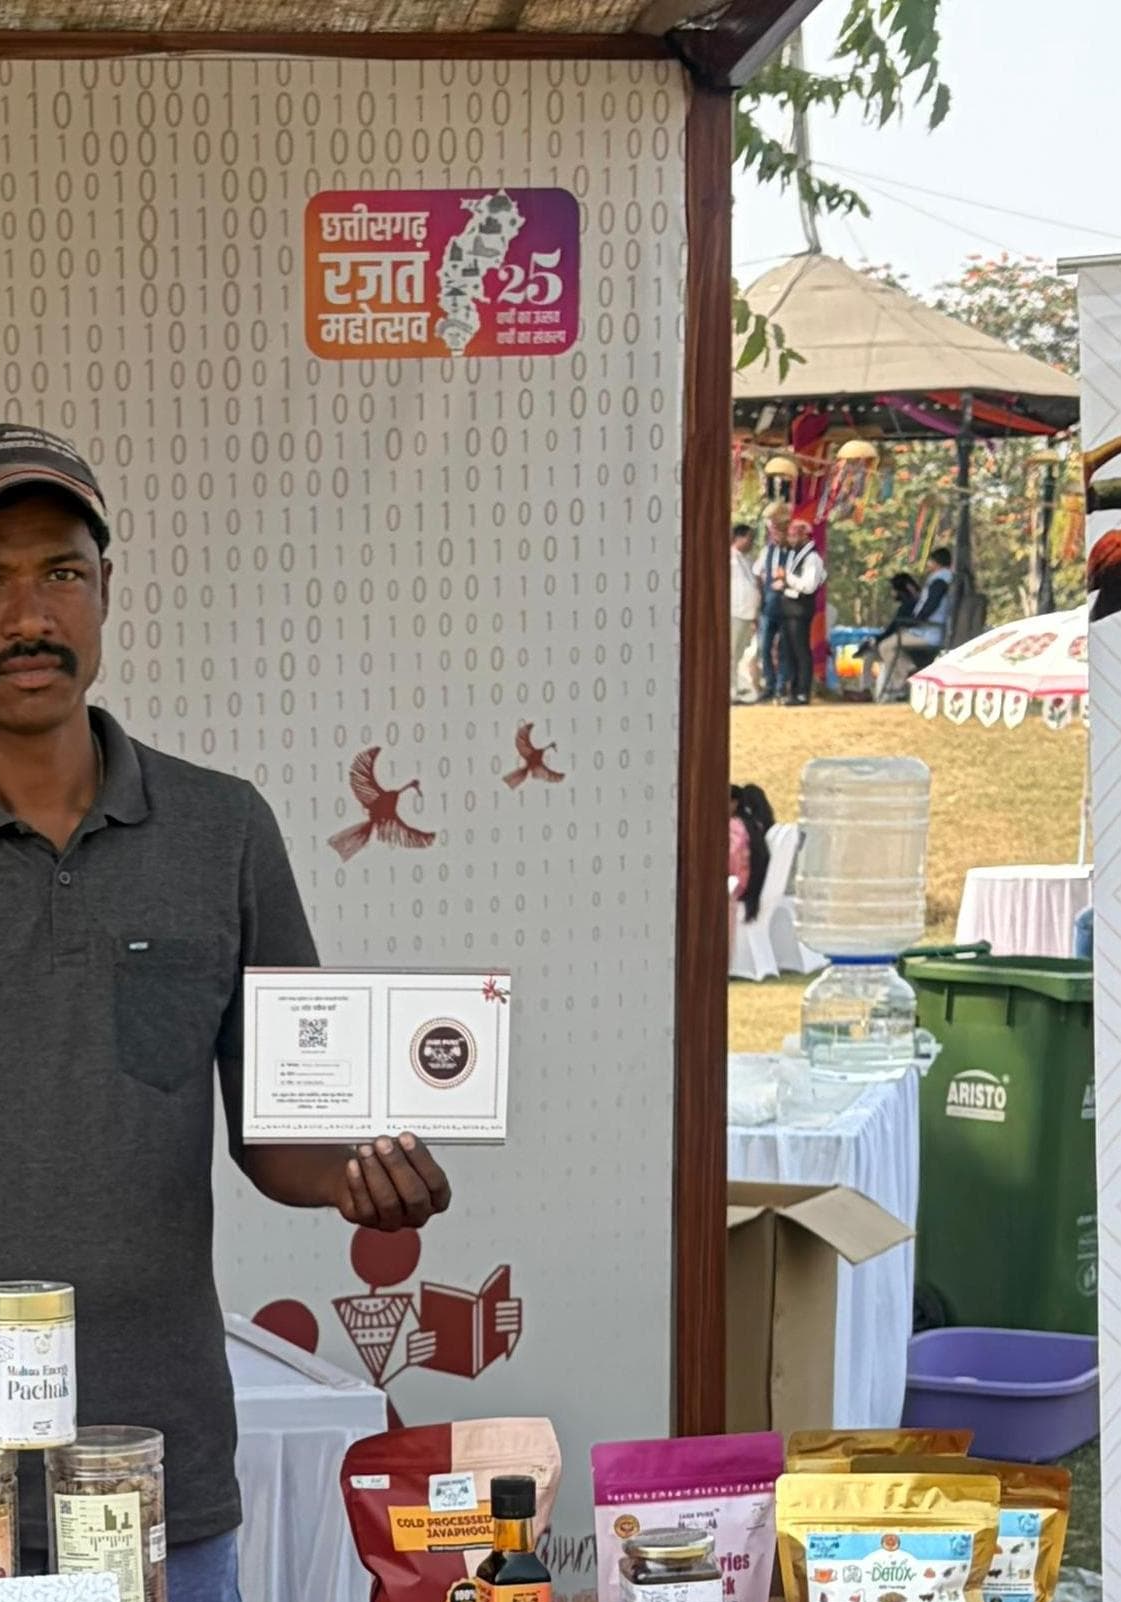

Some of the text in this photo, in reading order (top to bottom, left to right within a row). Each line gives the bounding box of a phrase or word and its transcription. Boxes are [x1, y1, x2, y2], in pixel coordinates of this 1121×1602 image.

[318, 203, 430, 249] छत्तीसगढ़
[317, 251, 431, 305] रजत
[497, 248, 563, 305] 25
[317, 302, 431, 345] महोत्सव
[947, 1081, 1007, 1109] ARISTO
[8, 1377, 69, 1400] Pachak
[397, 1514, 492, 1528] COLD PROCESSED
[719, 1552, 750, 1572] ries
